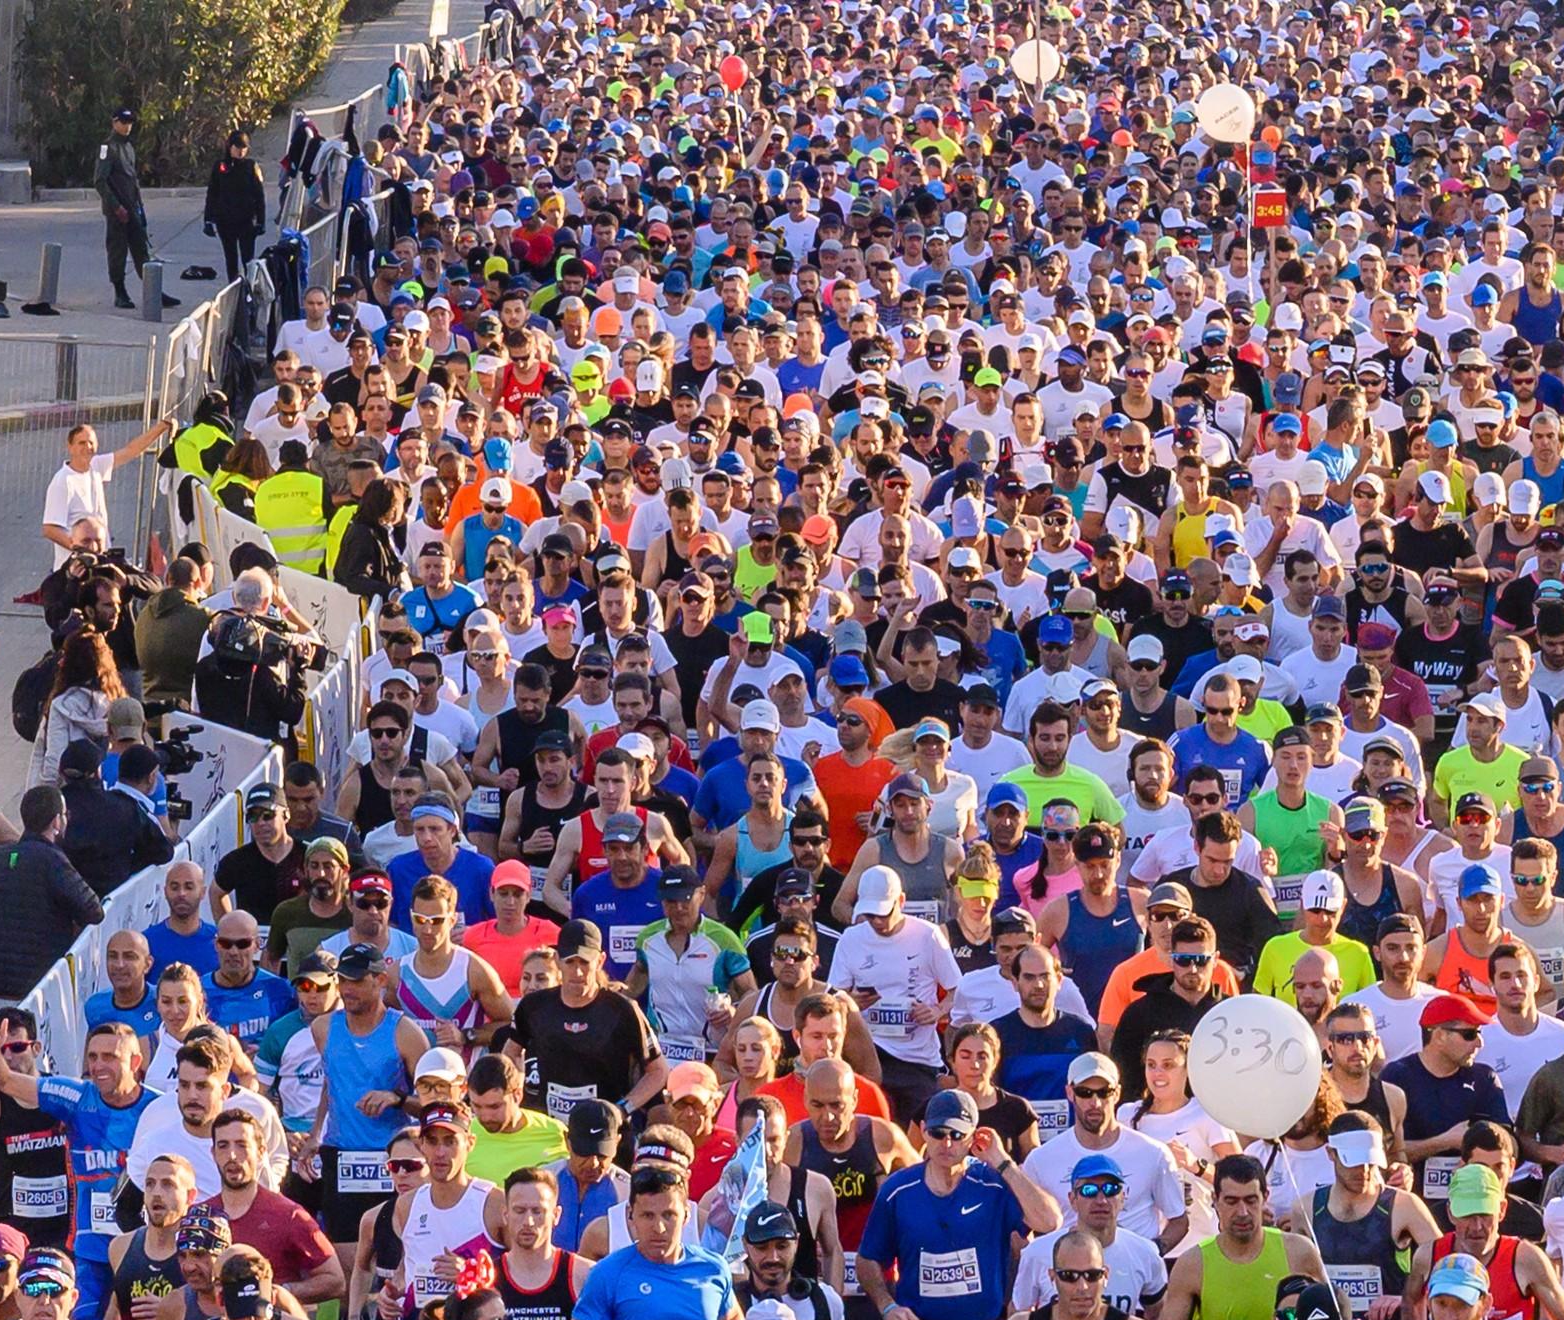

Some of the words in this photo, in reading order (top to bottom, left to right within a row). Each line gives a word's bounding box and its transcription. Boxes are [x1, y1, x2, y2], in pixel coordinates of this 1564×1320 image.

[1256, 205, 1283, 217] 3:45
[1414, 660, 1463, 680] MyWay
[879, 1010, 903, 1024] 1131
[1205, 1016, 1307, 1076] 3:30
[11, 1133, 30, 1141] TEAM
[355, 1165, 375, 1178] 347
[27, 1193, 54, 1205] 2605
[934, 1268, 962, 1281] 2639
